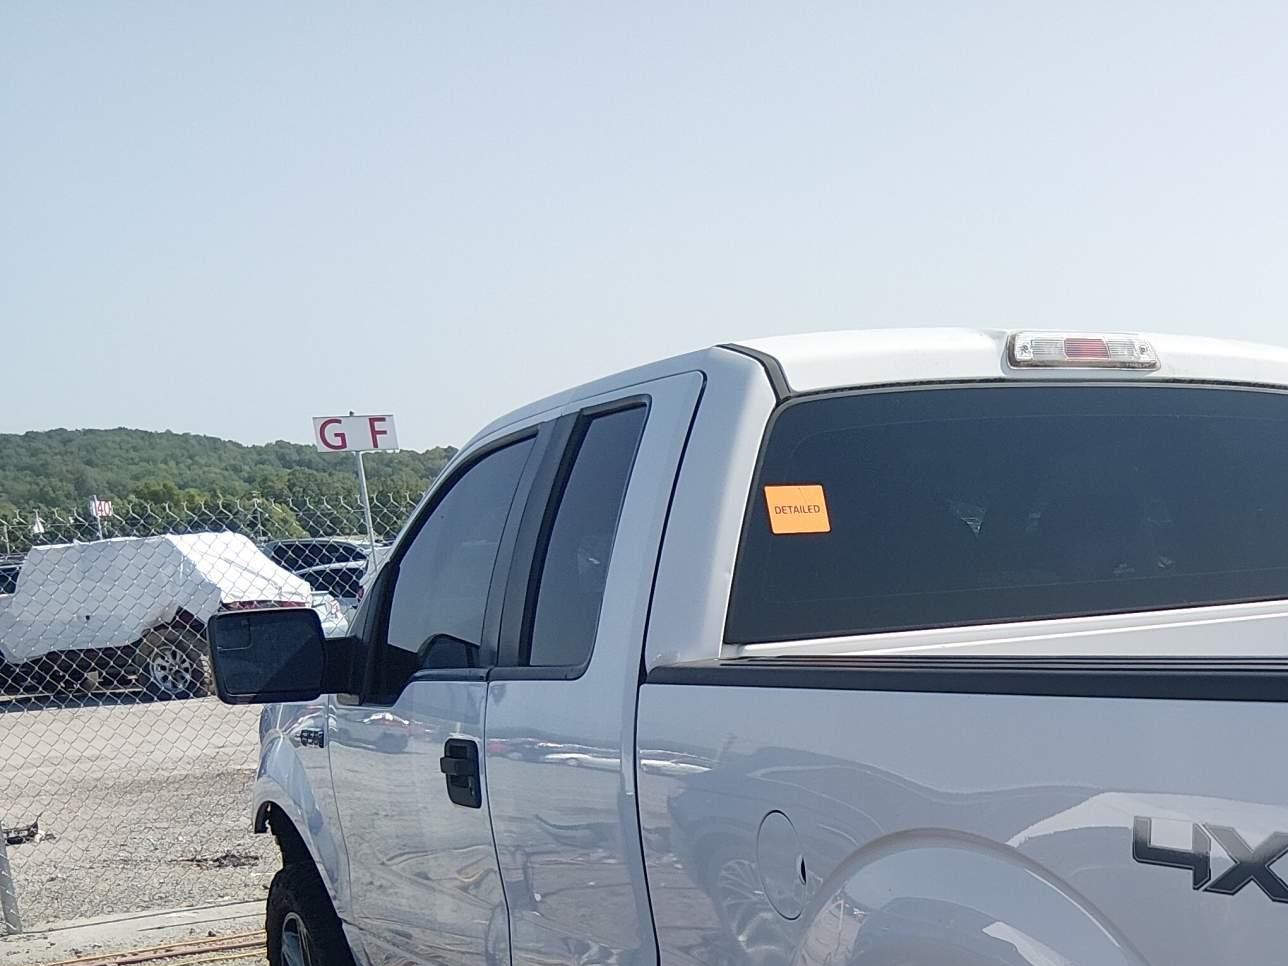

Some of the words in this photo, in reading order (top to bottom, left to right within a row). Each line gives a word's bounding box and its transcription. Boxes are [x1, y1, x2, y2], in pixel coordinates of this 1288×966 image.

[319, 418, 348, 450] G
[368, 417, 388, 448] F
[774, 504, 821, 515] DETAILED
